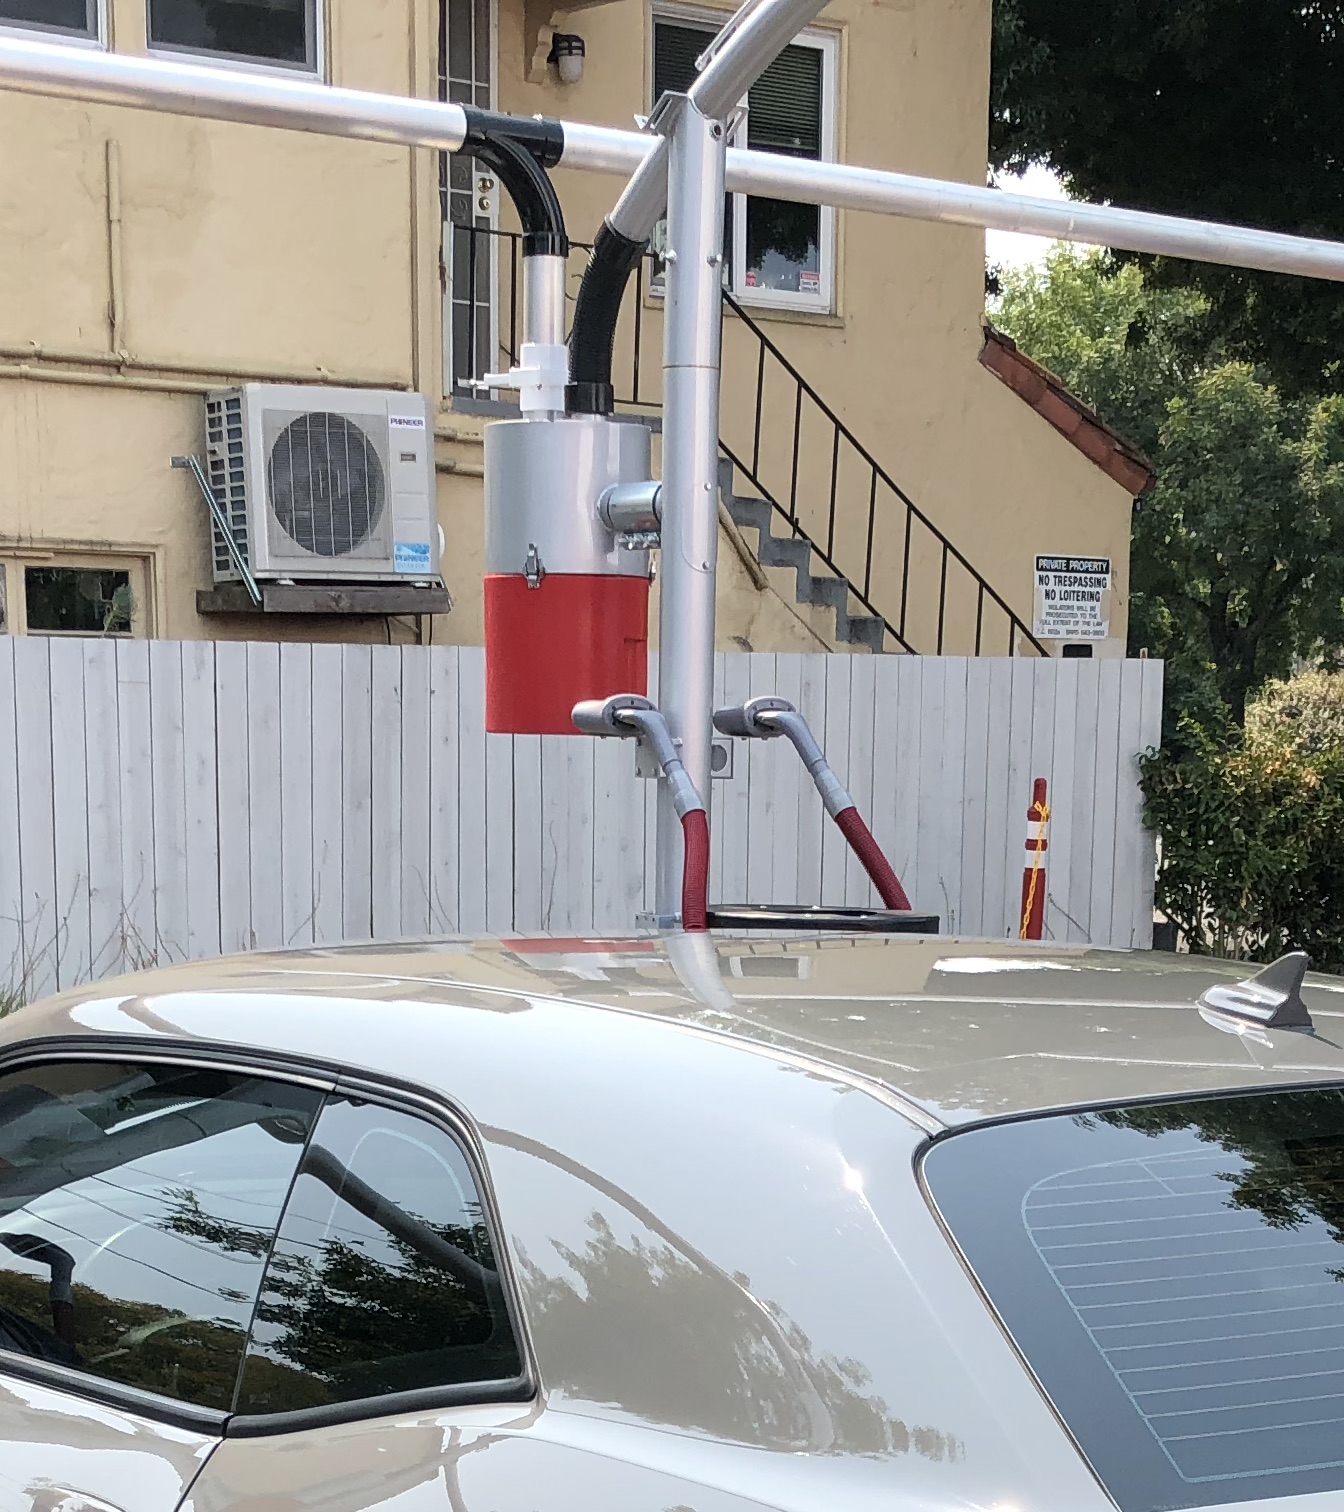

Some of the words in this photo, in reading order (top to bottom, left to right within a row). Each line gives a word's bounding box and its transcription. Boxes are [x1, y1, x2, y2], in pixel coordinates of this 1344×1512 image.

[390, 417, 424, 427] PIONEER
[394, 553, 430, 563] PIONEER
[1038, 558, 1067, 570] PRIVATE
[1069, 560, 1107, 572] PROPERTY
[1038, 574, 1050, 587] NO
[1053, 575, 1107, 588] TRESPASSING
[1044, 589, 1056, 601] NO
[1059, 589, 1101, 602] LOITERING
